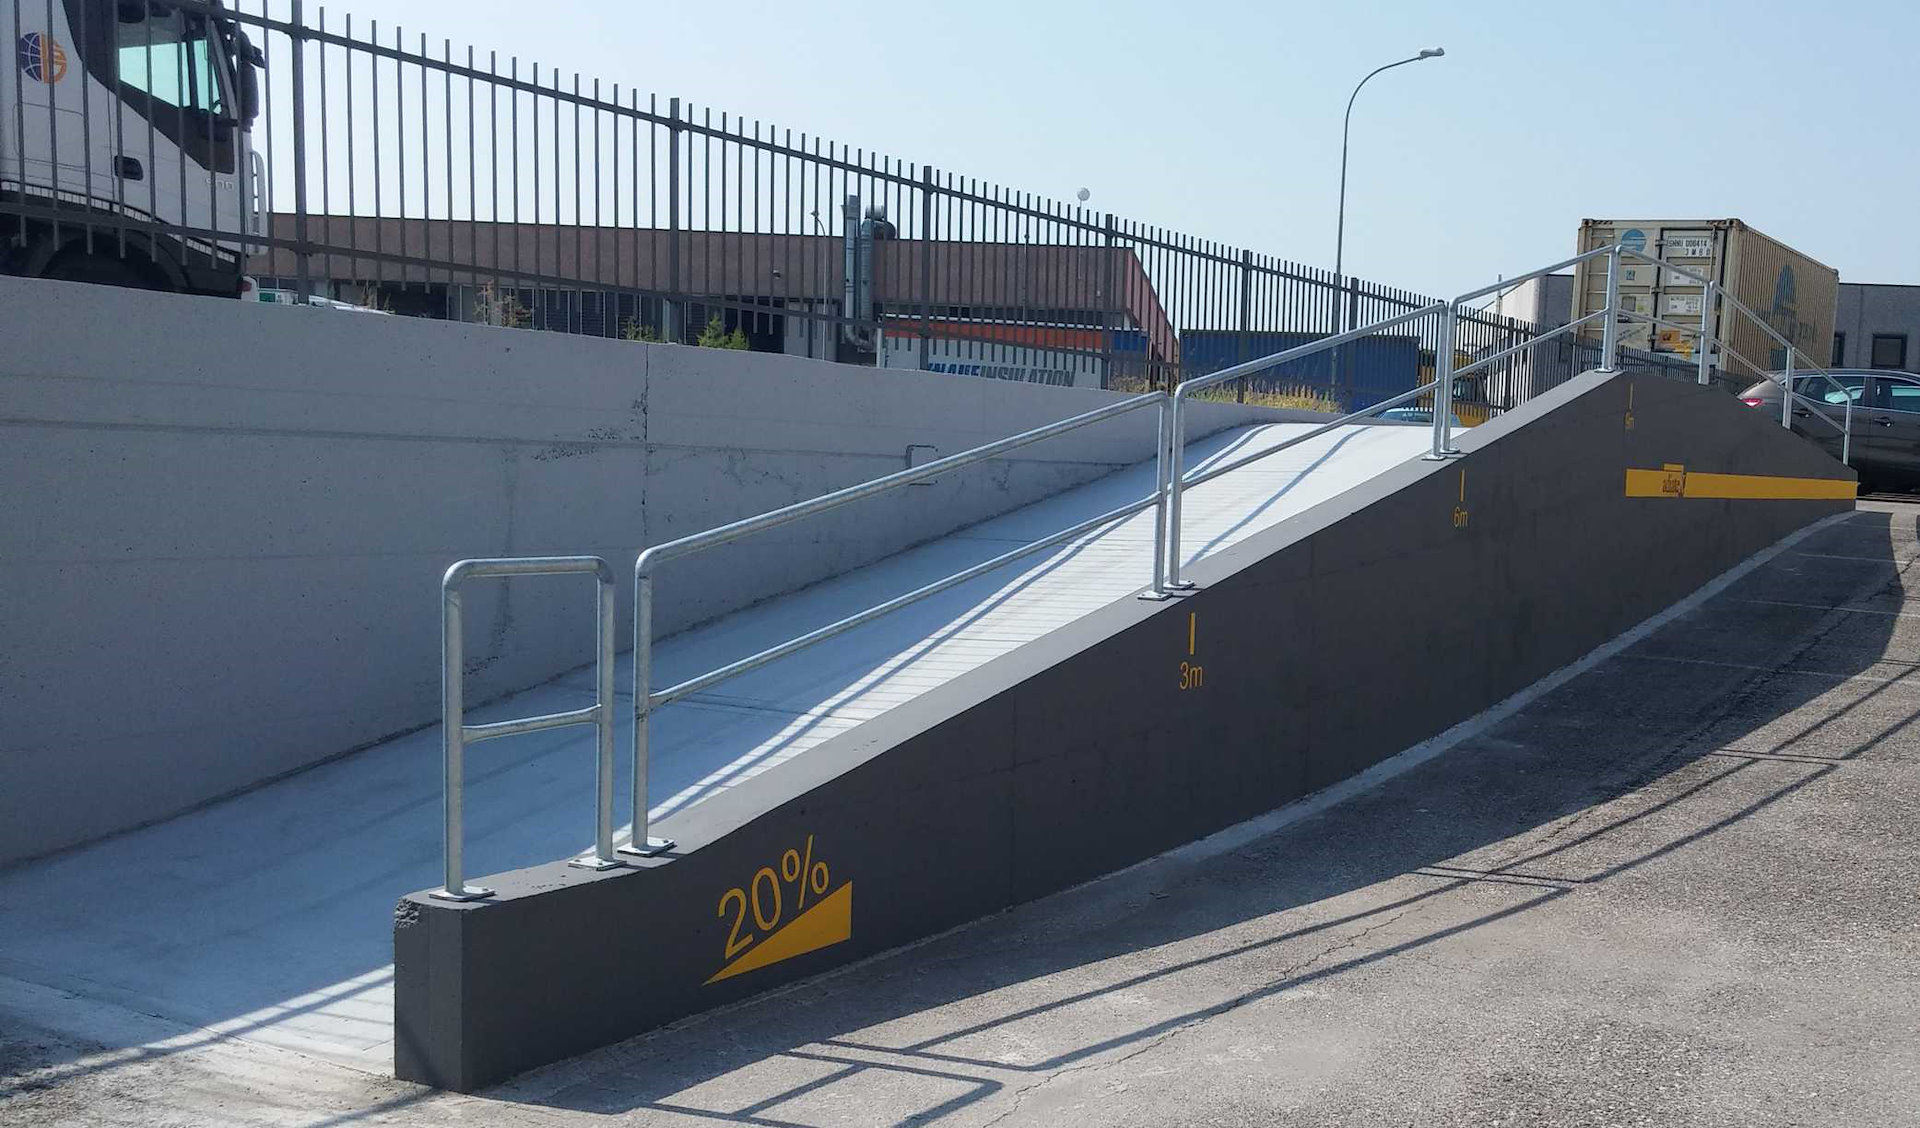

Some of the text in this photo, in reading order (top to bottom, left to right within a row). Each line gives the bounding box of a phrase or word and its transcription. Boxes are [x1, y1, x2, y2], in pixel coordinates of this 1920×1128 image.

[1453, 506, 1468, 528] 6m
[1179, 661, 1203, 690] 3m
[718, 834, 830, 960] 20%
